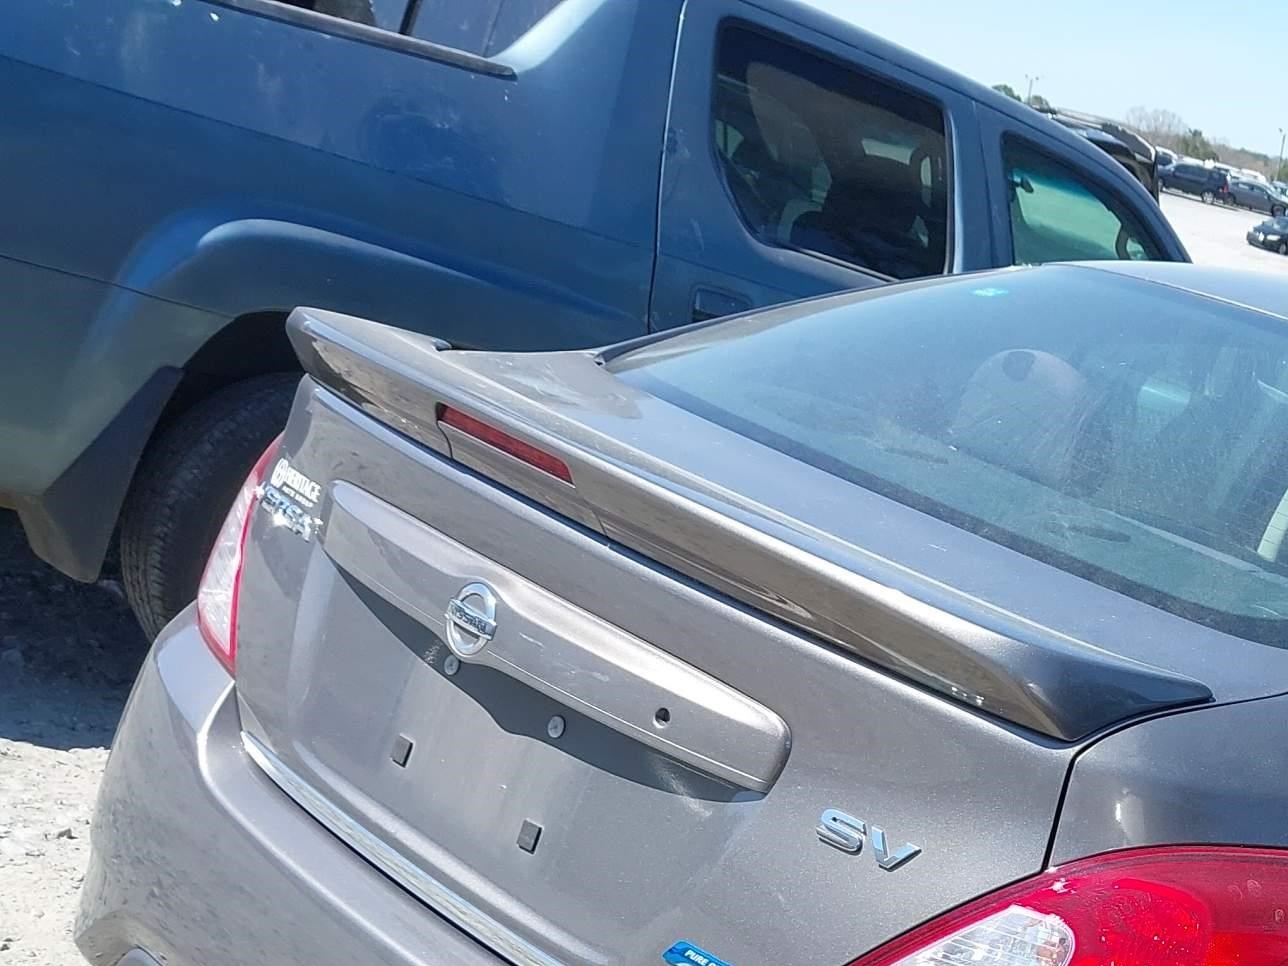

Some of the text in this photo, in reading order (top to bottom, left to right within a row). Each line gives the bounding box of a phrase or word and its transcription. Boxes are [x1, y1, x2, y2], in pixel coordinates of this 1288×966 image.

[285, 466, 321, 503] HERITAGE
[816, 808, 922, 872] SV
[684, 949, 709, 966] PURE
